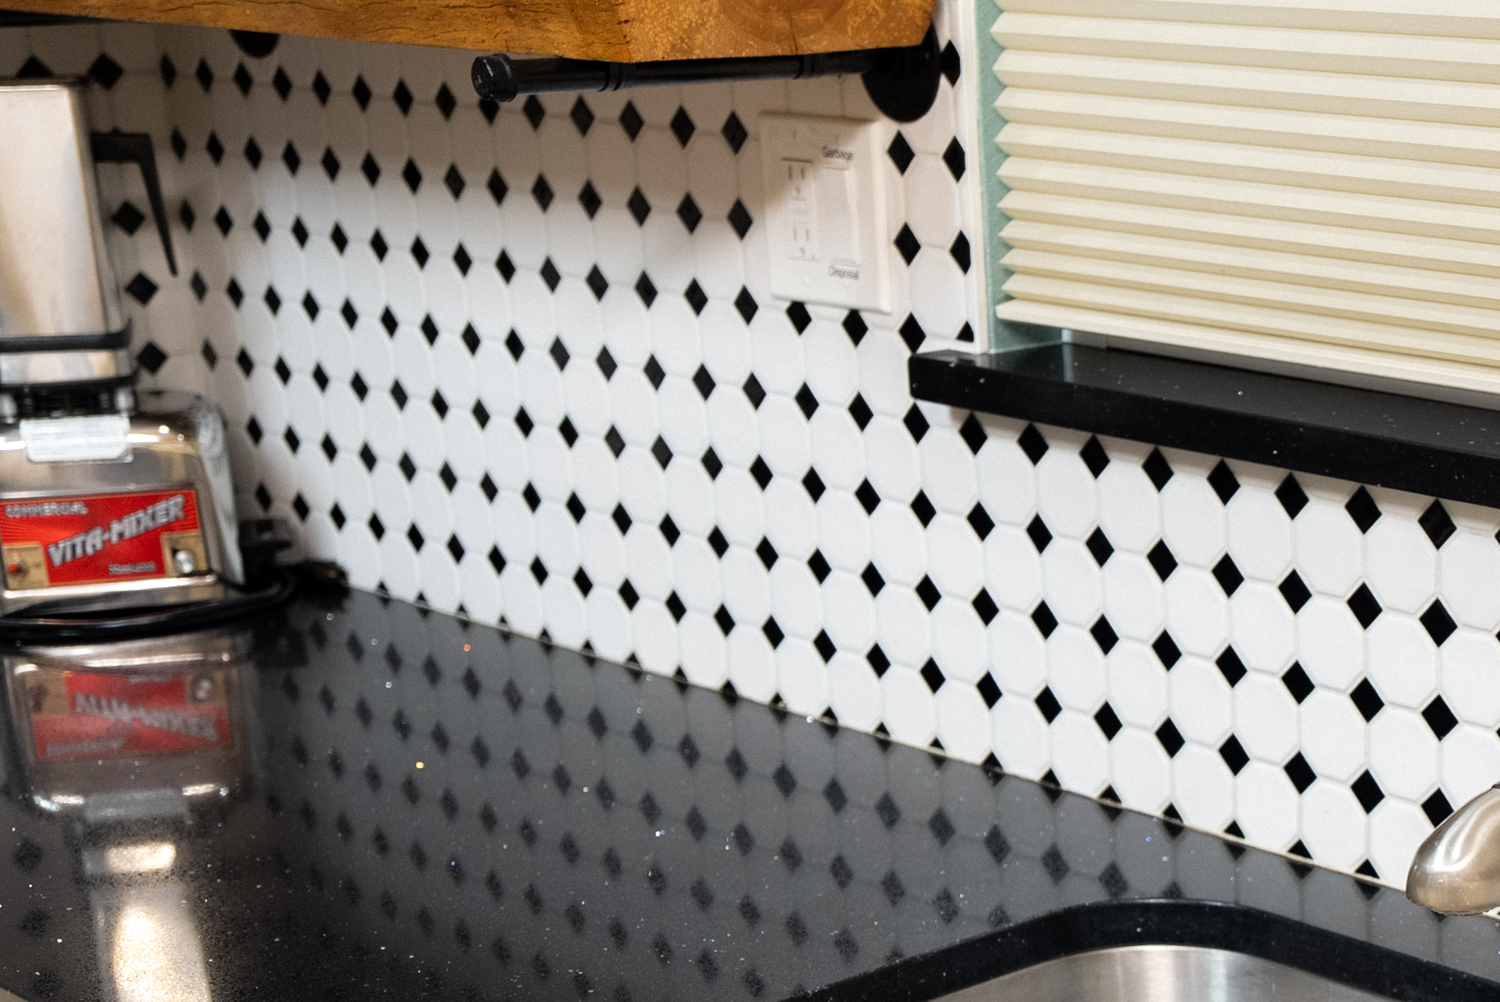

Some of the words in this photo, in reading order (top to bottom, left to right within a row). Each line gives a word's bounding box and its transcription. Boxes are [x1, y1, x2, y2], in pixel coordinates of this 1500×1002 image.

[821, 145, 854, 162] Garbage
[828, 264, 860, 280] Disposal
[47, 494, 186, 567] VITA-MIXER
